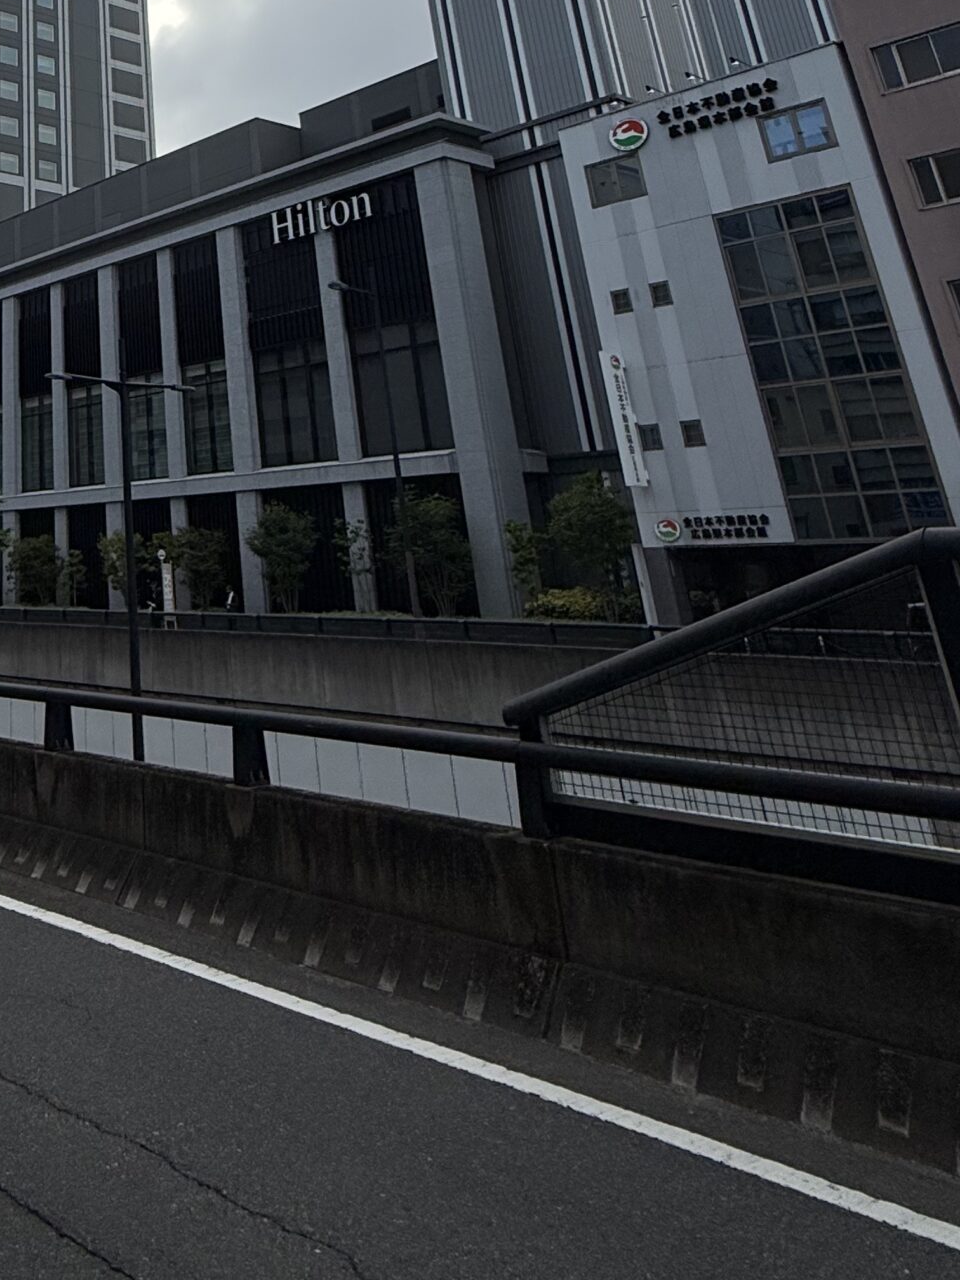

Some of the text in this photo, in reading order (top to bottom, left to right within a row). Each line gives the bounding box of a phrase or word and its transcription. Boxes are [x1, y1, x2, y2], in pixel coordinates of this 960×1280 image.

[656, 77, 779, 125] 全日本不動産協会
[271, 192, 373, 245] Hilton
[682, 513, 770, 529] 全日本不動産協会
